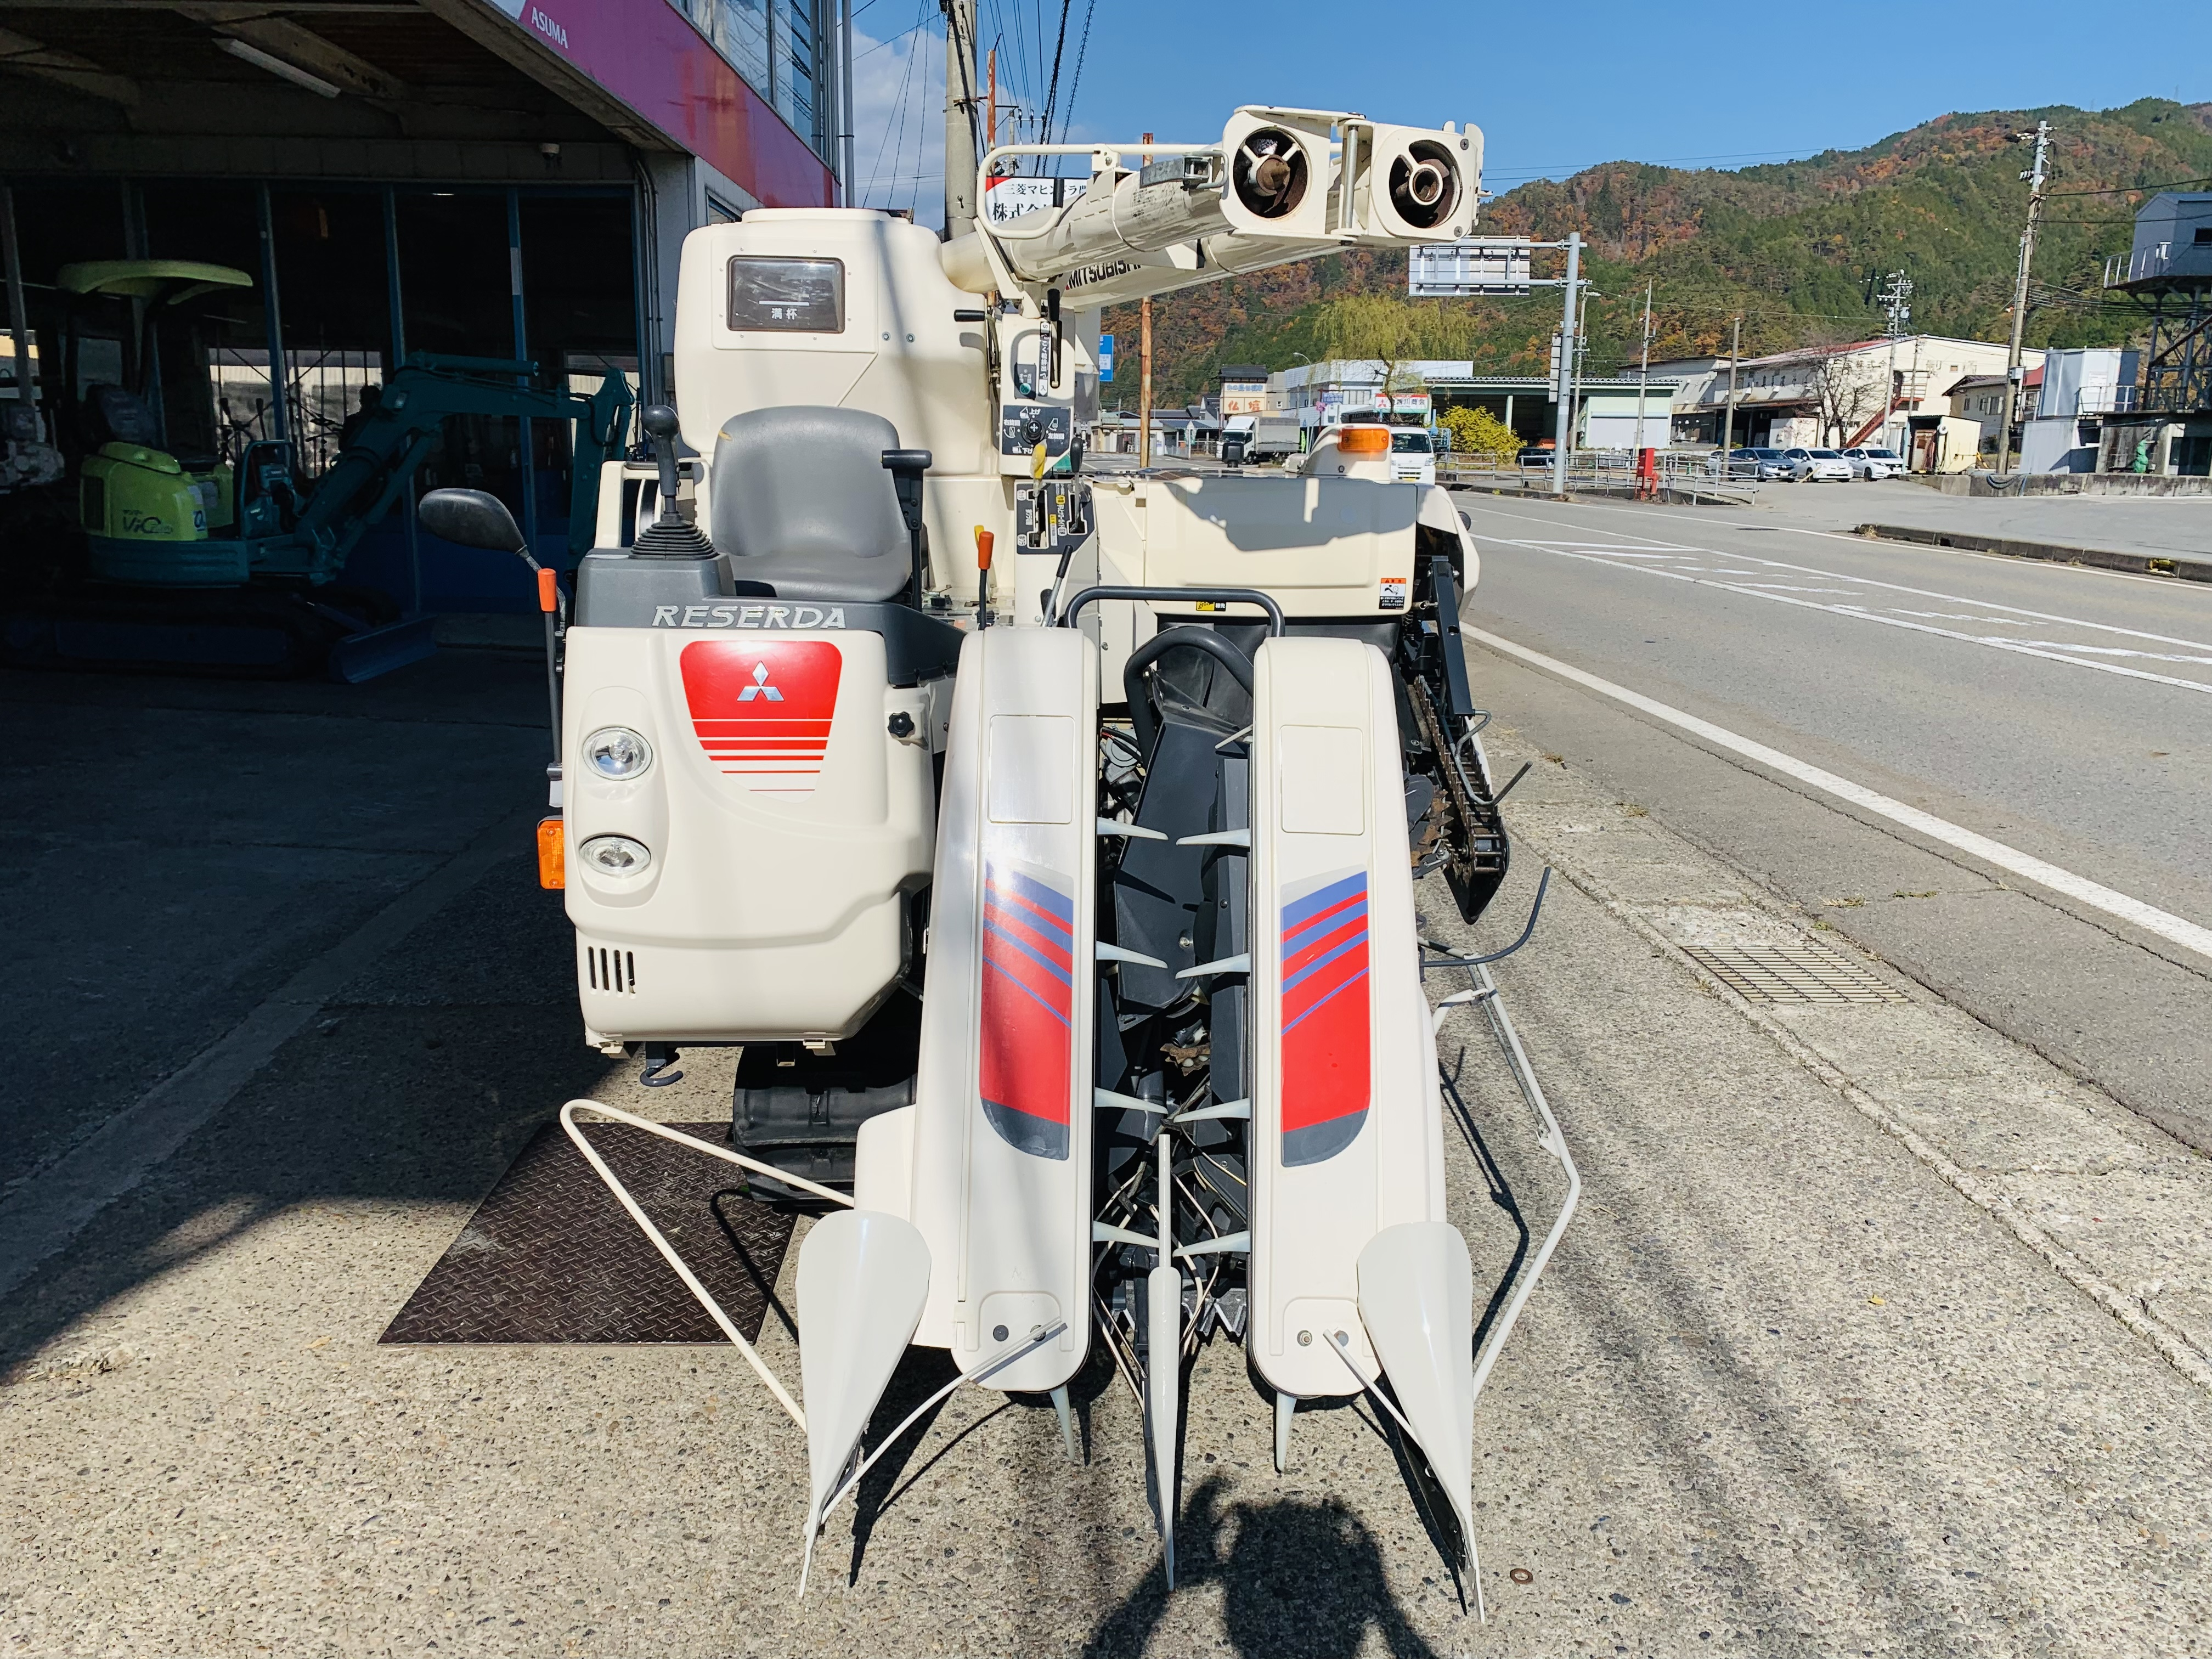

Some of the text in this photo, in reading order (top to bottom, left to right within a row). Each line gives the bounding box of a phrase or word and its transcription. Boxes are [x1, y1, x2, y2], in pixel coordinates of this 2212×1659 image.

[532, 7, 568, 49] ASUMA
[992, 202, 1046, 221] 株式
[771, 308, 797, 320] 満杯
[652, 605, 846, 629] RESERDA
